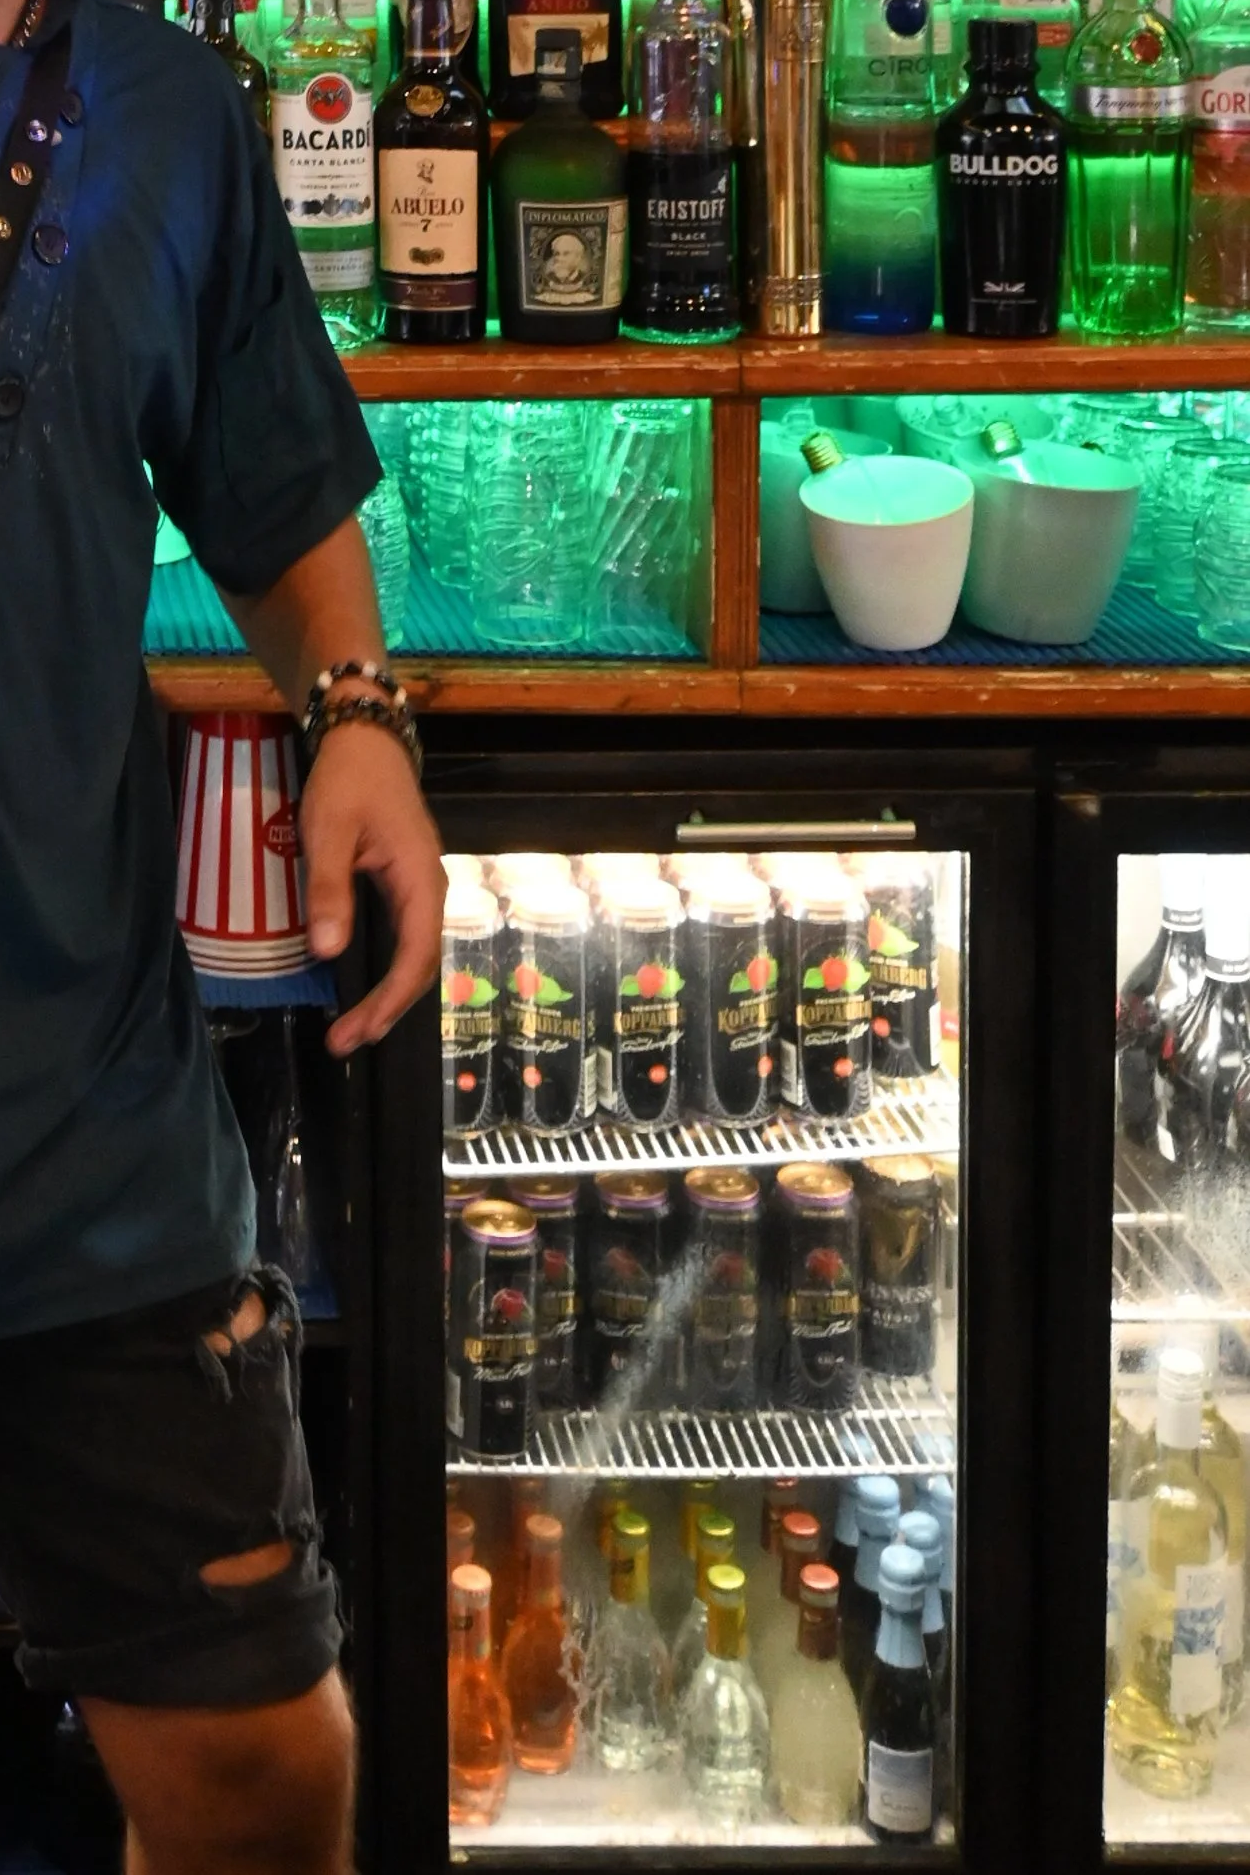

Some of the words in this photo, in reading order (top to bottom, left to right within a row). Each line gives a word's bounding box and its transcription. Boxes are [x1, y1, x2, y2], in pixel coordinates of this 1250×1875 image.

[282, 121, 371, 150] BACARDÍ
[289, 158, 324, 167] CARTA
[950, 153, 1058, 176] BULLDOG
[391, 197, 465, 215] ABUELO
[647, 198, 726, 220] ERISTOFF
[420, 219, 431, 233] 7
[670, 232, 706, 241] BLACK
